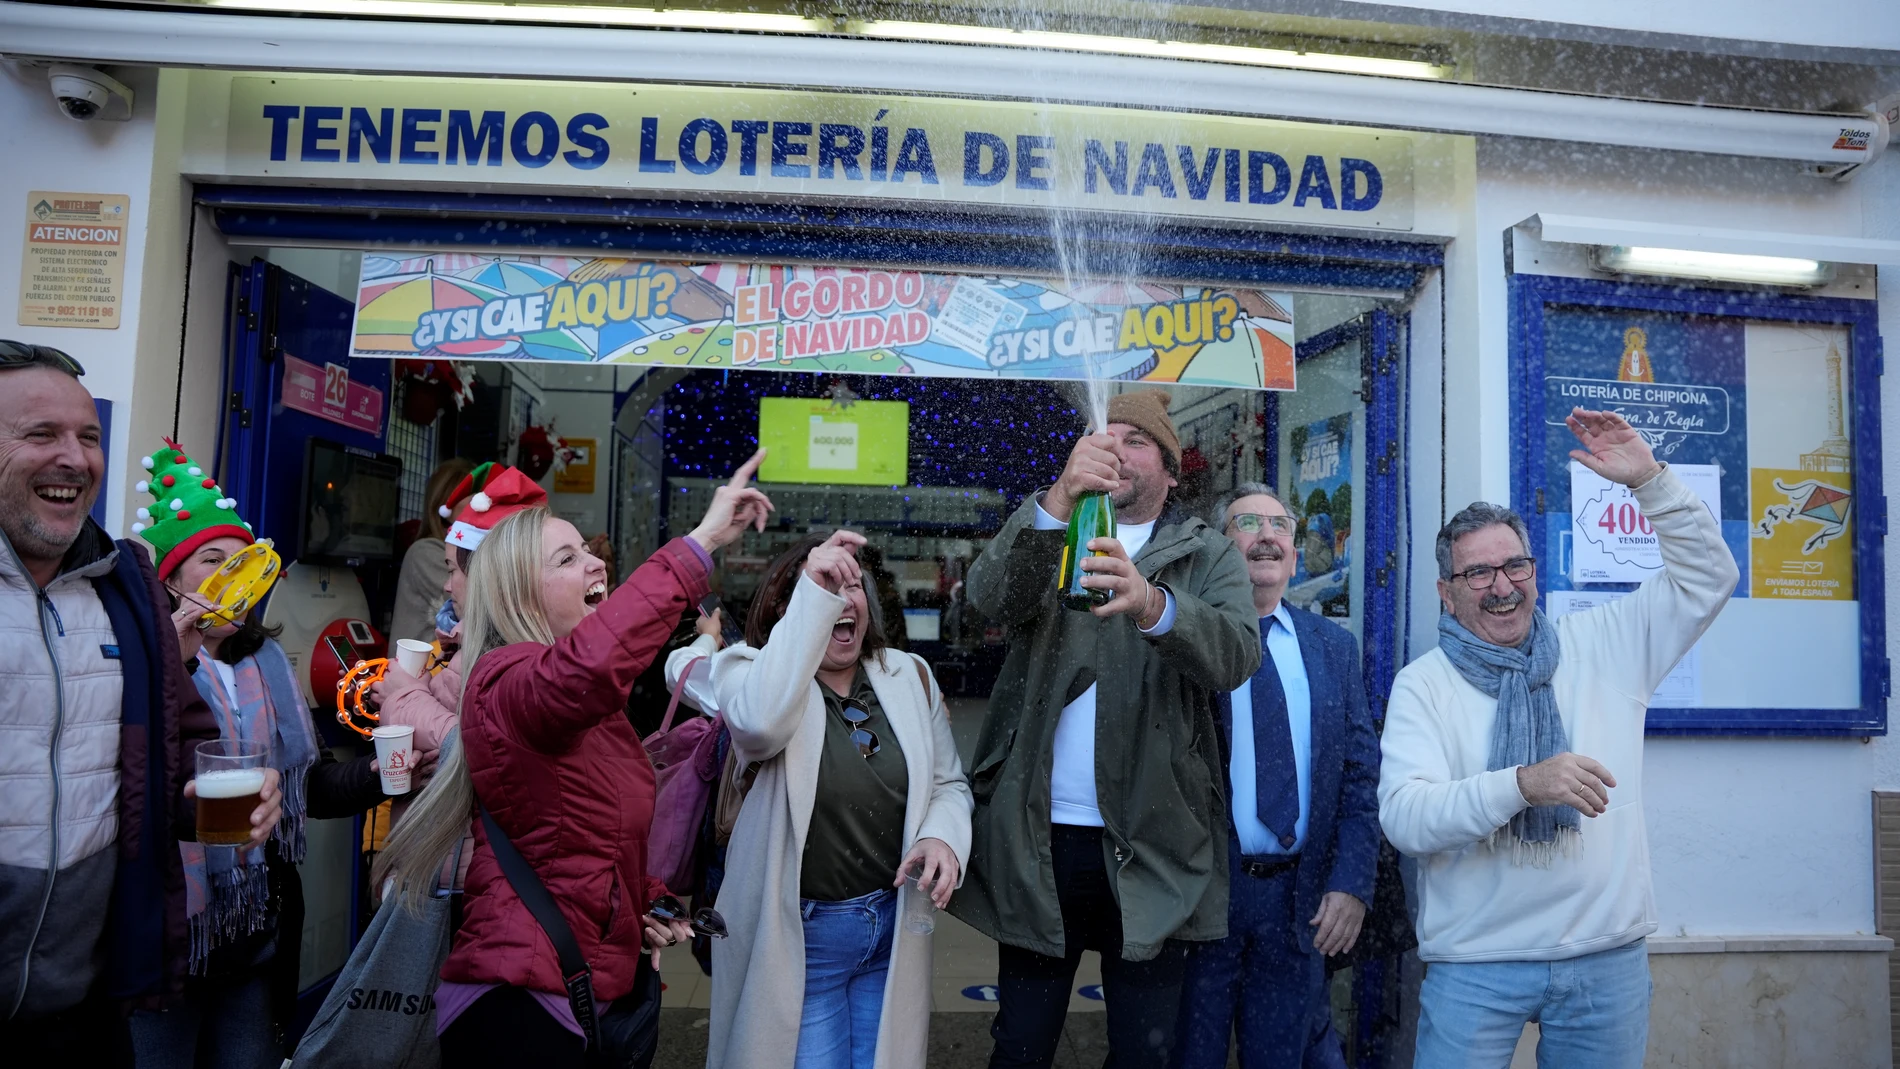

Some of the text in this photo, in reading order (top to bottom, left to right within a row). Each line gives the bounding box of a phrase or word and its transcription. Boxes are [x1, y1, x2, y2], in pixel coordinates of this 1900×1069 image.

[1840, 129, 1871, 138] Toldos
[263, 105, 1383, 212] TENEMOS LOTERÍA DE NAVIDAD
[33, 226, 119, 242] ATENCION
[31, 247, 118, 258] PROPIEDAD PROTEGIDA CON
[39, 257, 108, 266] SISTEMA ELECTRONICO
[51, 266, 66, 274] ALTA
[32, 275, 76, 283] TRANSMISION
[86, 275, 112, 284] SEÑALES
[42, 284, 67, 292] ALARMA
[66, 294, 88, 302] ORDEN
[89, 295, 116, 303] PUBLICO
[449, 308, 478, 341] SI
[480, 294, 545, 337] CAE
[545, 264, 678, 329] AQUÍ?
[737, 285, 776, 324] EL
[783, 272, 923, 319] GORDO
[57, 305, 76, 316] 902
[77, 306, 87, 316] 11
[88, 307, 100, 317] 91
[101, 307, 114, 317] 96
[1023, 328, 1050, 362] SI
[1052, 315, 1115, 358] CAE
[1116, 289, 1239, 351] AQUÍ?
[734, 328, 776, 363] DE
[784, 312, 930, 358] NAVIDAD
[326, 365, 347, 404] 26
[300, 389, 315, 402] BOTE
[1561, 383, 1709, 405] LOTERÍA DE CHIPIONA
[1646, 410, 1660, 425] de
[1663, 410, 1704, 430] Regla
[1320, 440, 1339, 457] CAE
[1621, 489, 1627, 498] 2
[1618, 536, 1656, 544] VENDIDO
[1765, 578, 1805, 587] ENVIAMOS
[1780, 588, 1800, 596] TODA
[1801, 587, 1833, 597] ESPAÑA
[382, 768, 410, 776] Cruzca
[347, 988, 436, 1016] SAMSU
